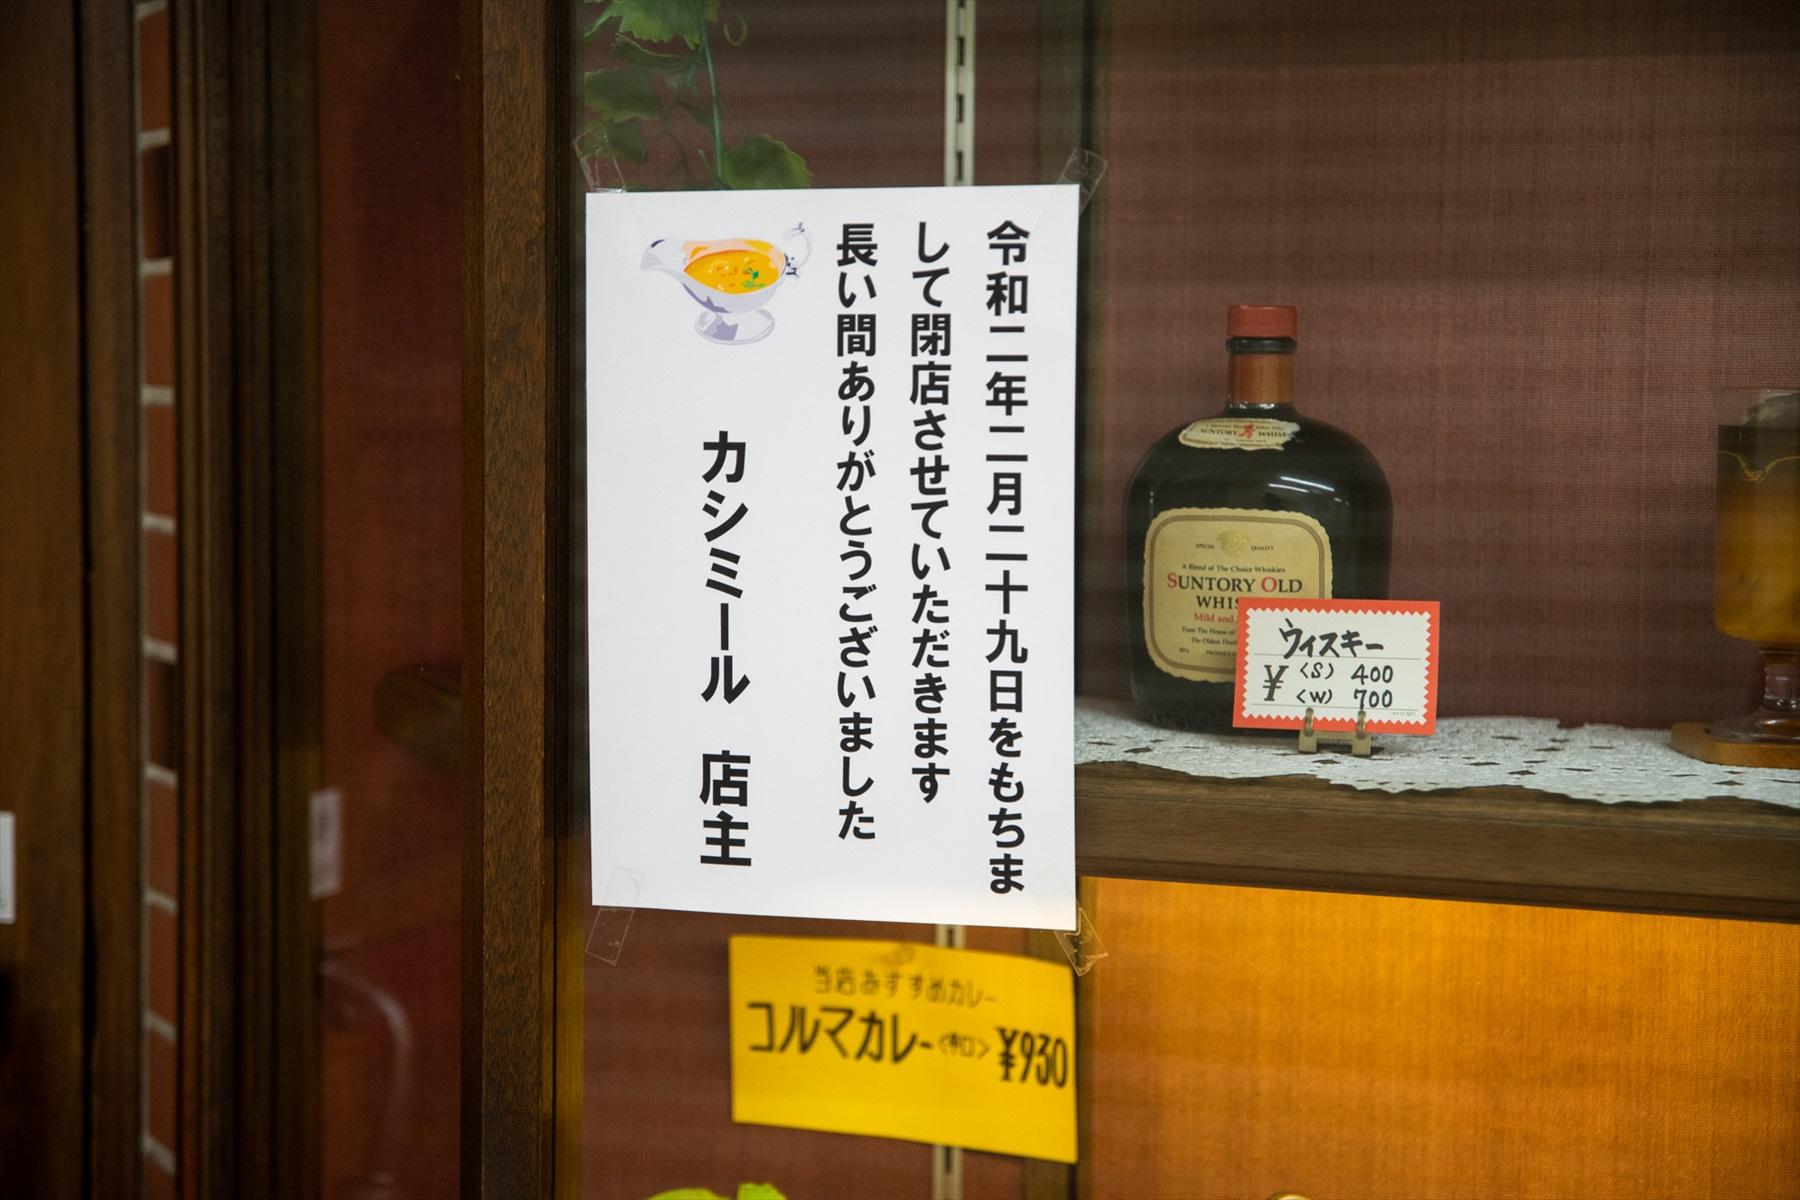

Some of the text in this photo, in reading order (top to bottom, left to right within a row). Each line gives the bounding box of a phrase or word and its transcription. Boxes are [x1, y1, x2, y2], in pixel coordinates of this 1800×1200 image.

[836, 223, 879, 840] 長い間ありがとうございました
[909, 221, 952, 804] して閉店させていただきます
[985, 220, 1030, 895] 令和二年二月二十九日をもちま
[1216, 565, 1229, 573] The
[1167, 573, 1303, 594] SUNTORY OLD
[1194, 612, 1235, 624] Mild and
[1278, 617, 1385, 660] ウィスキー
[699, 430, 752, 867] カシミール 店主
[1262, 664, 1290, 702] ¥
[1350, 663, 1394, 686] 400
[1353, 688, 1394, 709] 700
[995, 1025, 1069, 1090] ¥930
